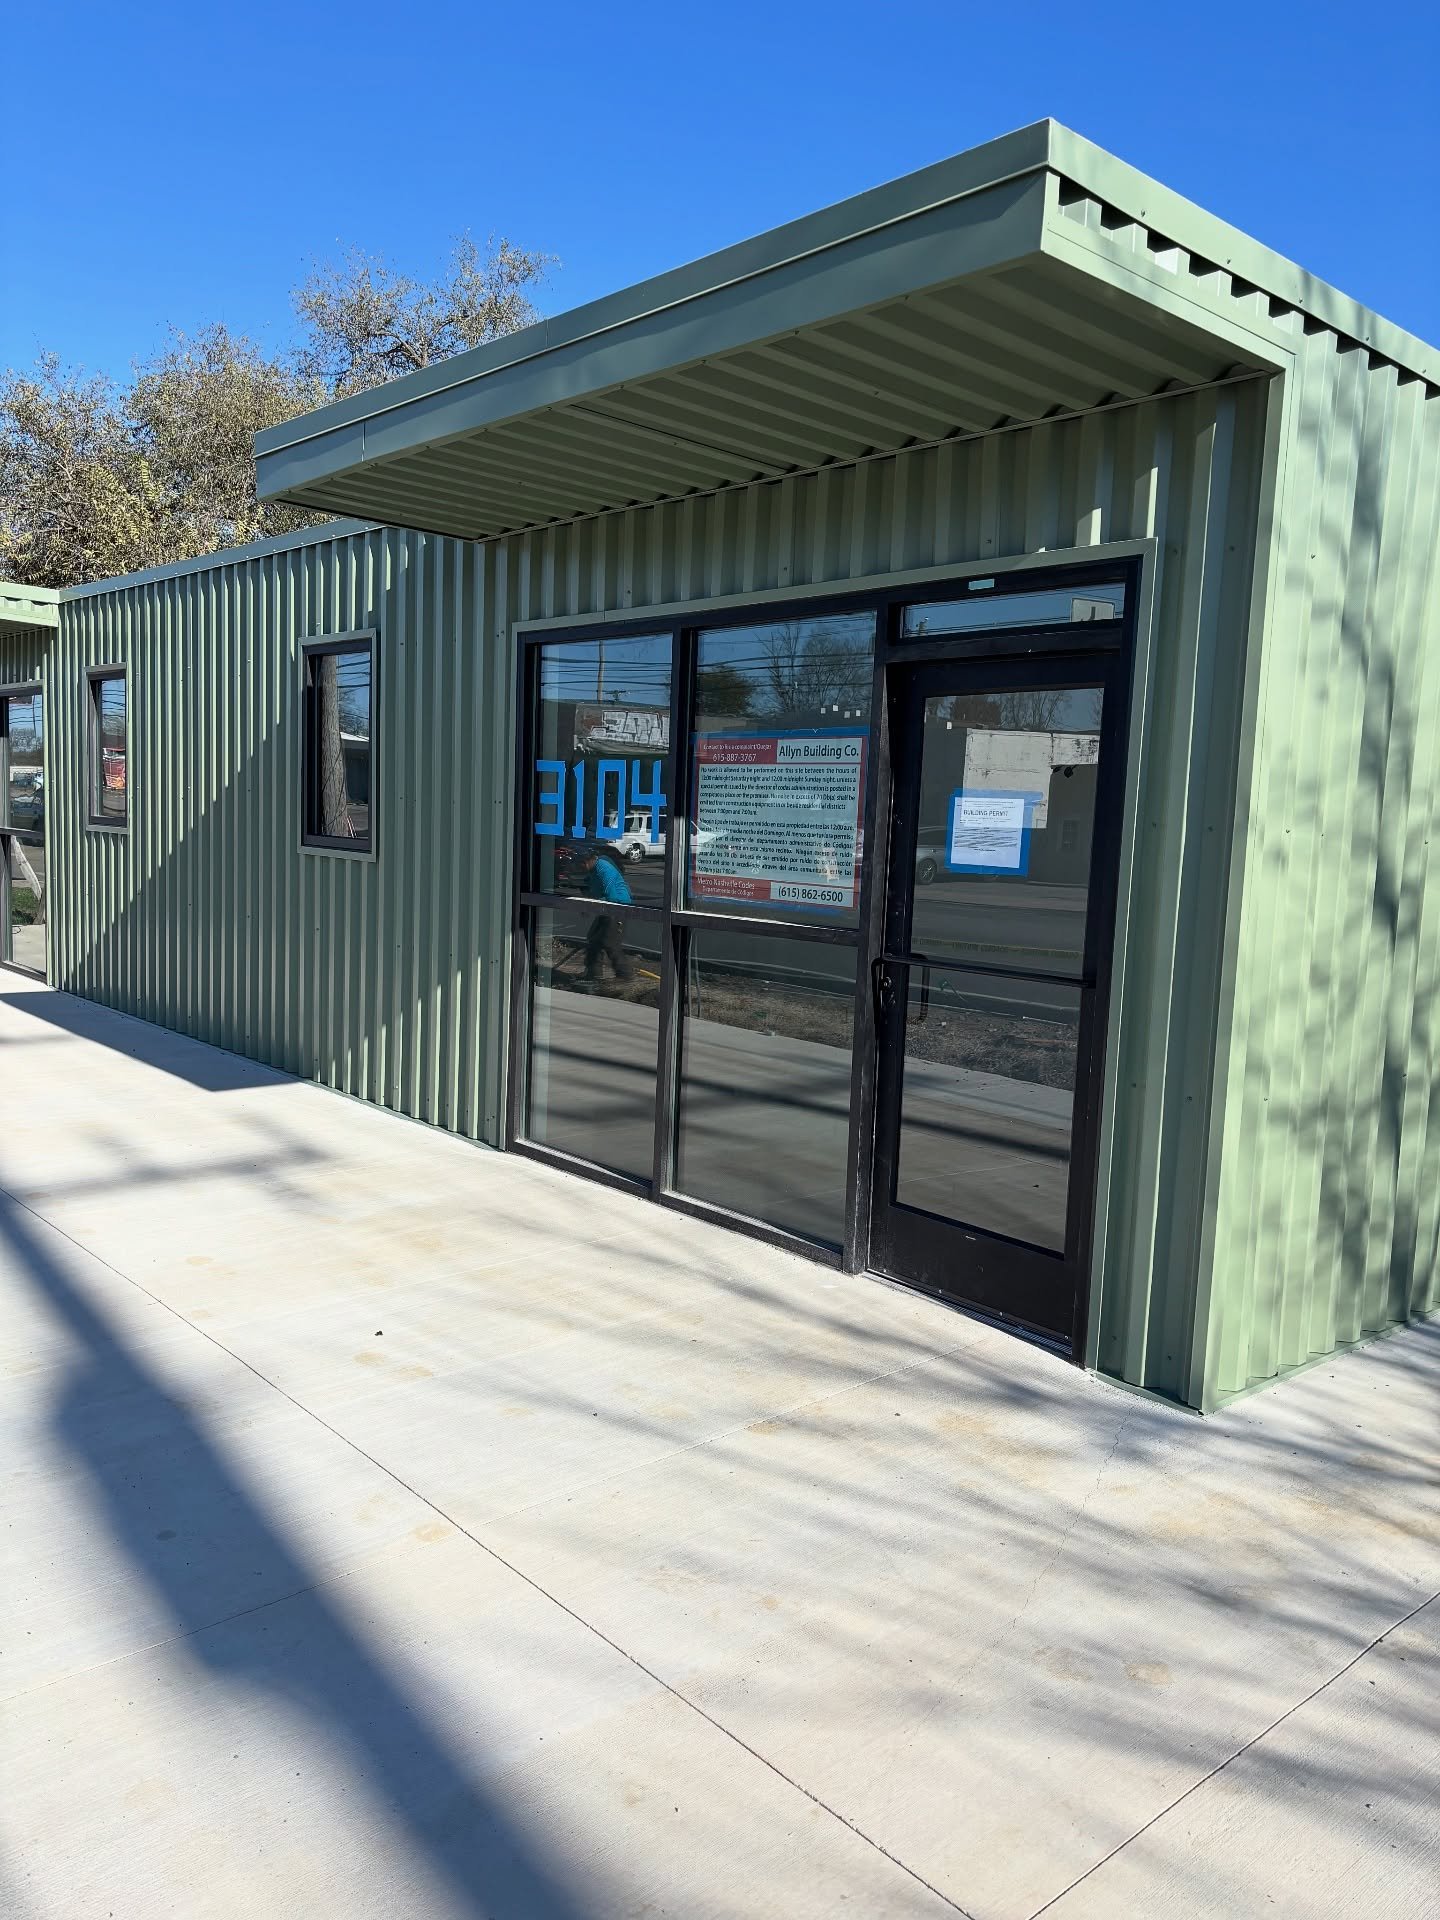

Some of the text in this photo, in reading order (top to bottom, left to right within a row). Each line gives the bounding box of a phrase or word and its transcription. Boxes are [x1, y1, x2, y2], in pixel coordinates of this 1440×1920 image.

[778, 745, 859, 759] Allyn Building Co.
[534, 760, 667, 844] 3104
[778, 886, 843, 902] (615) 862-6500
